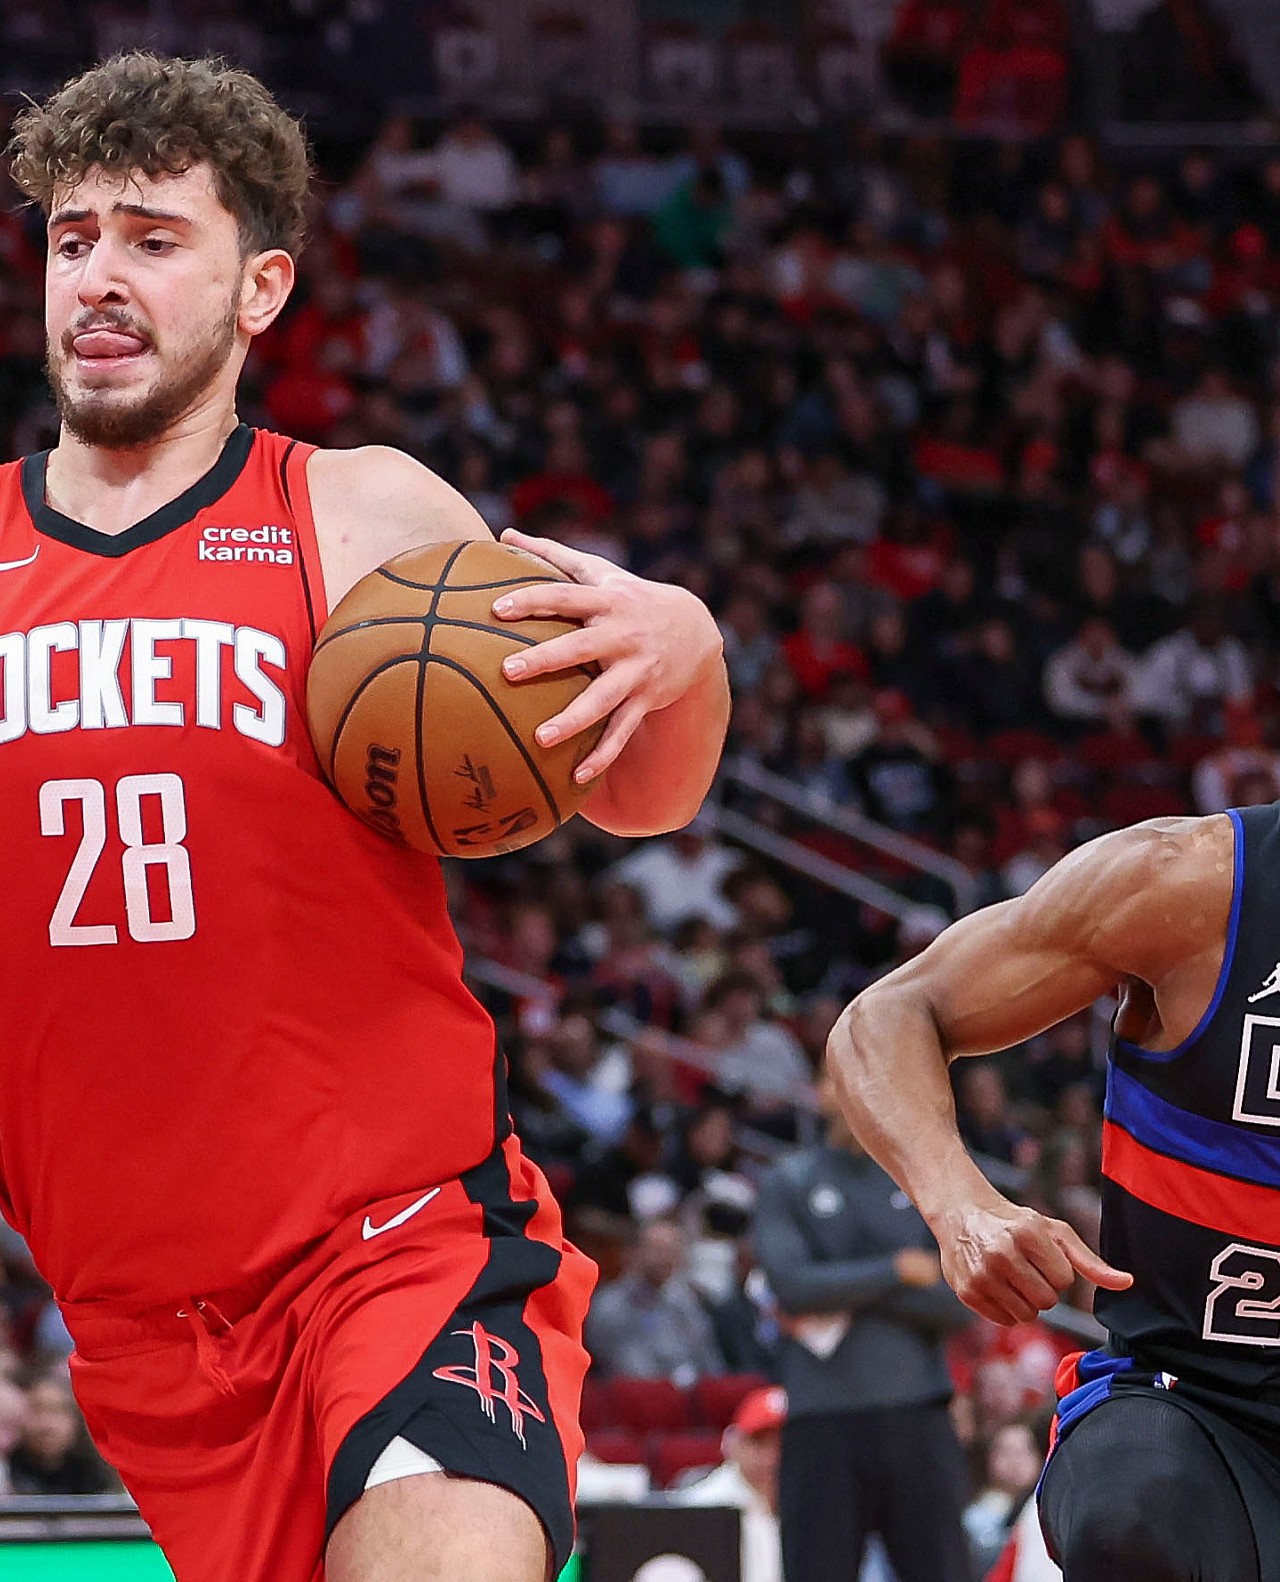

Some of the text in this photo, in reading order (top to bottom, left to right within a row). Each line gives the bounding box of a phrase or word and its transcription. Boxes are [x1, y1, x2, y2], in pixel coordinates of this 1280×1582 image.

[202, 526, 292, 544] credit
[198, 540, 293, 565] karma
[38, 773, 196, 947] 28
